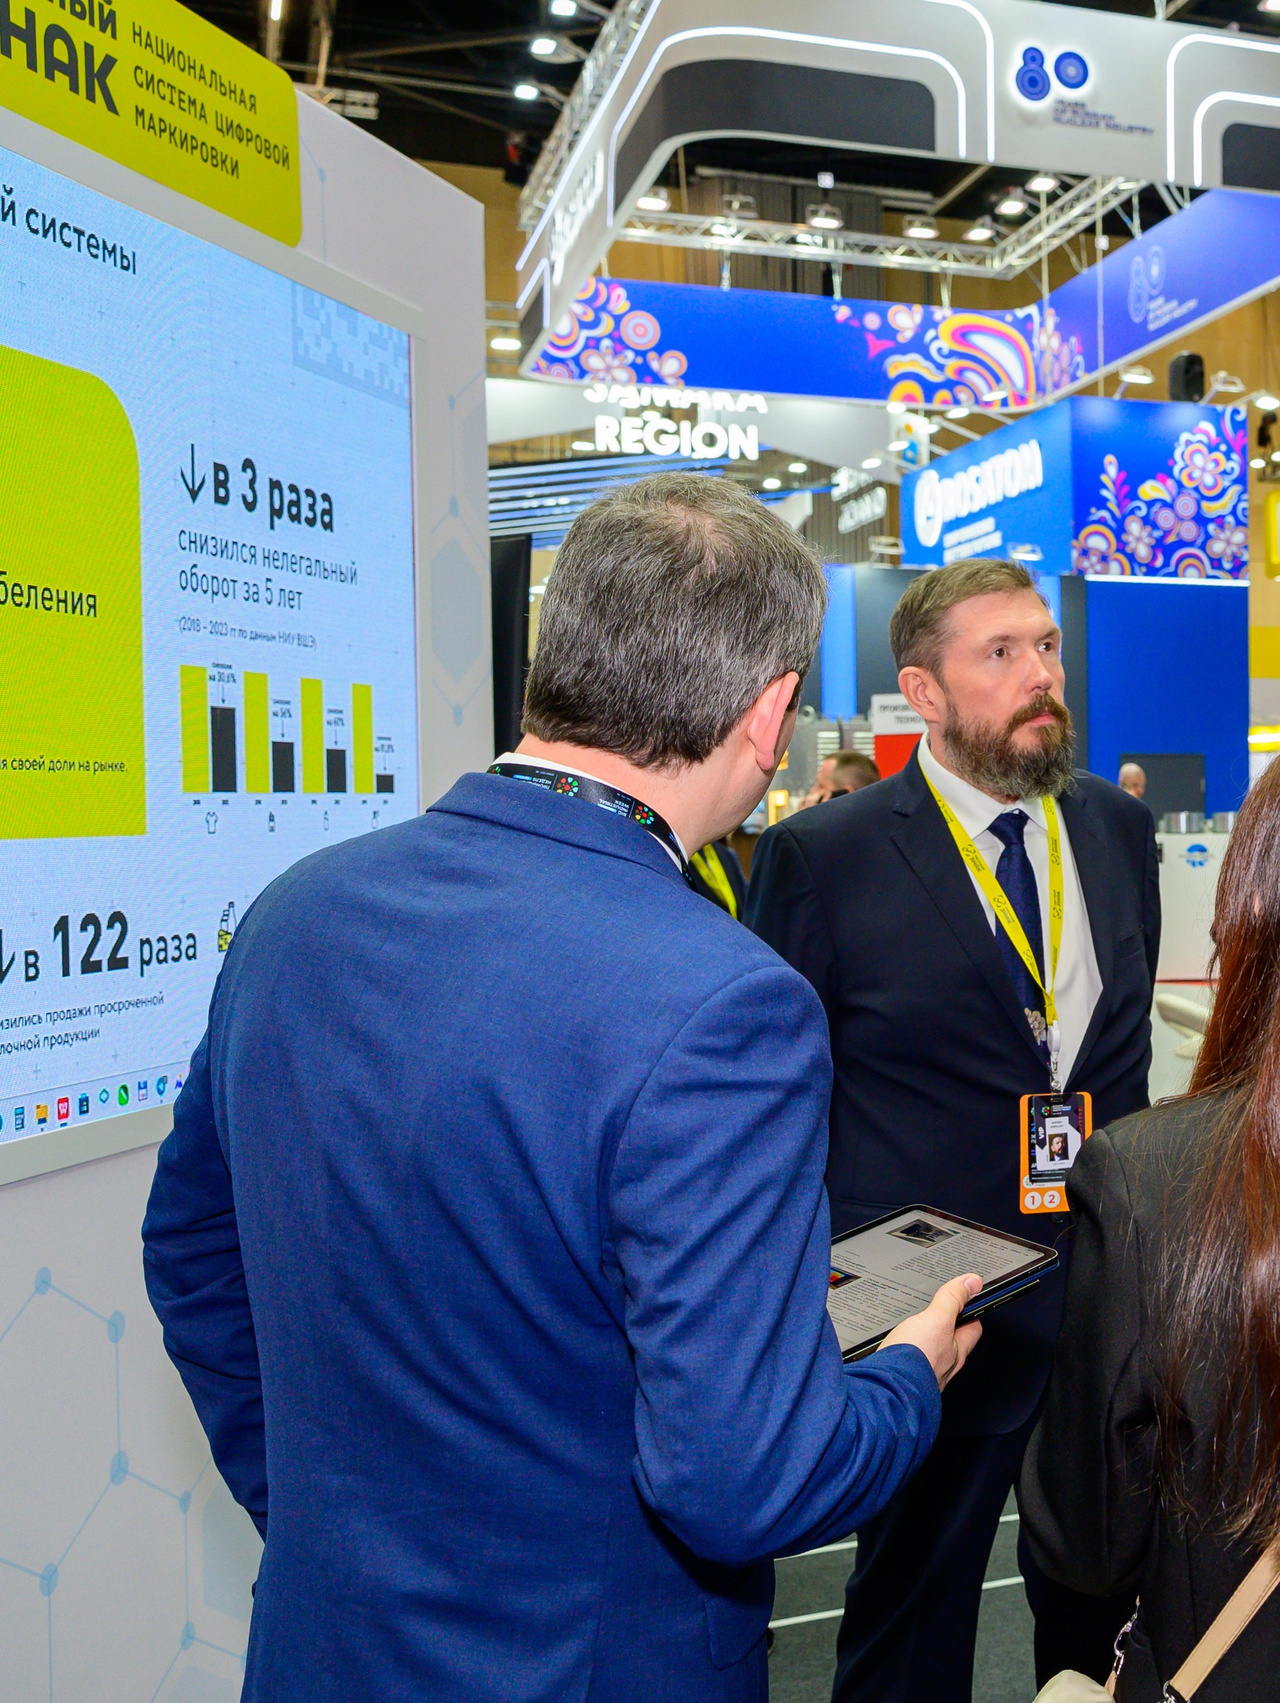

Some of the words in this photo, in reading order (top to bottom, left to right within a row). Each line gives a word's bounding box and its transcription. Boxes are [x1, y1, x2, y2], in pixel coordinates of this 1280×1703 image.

[48, 0, 117, 40] ЫЙ
[0, 0, 120, 117] НАК
[132, 21, 257, 115] НАЦИОНАЛЬНАЯ
[133, 65, 208, 125] СИСТЕМА
[215, 110, 290, 171] ЦИФРОВОЙ
[135, 104, 240, 180] МАРКИРОВКИ
[25, 207, 137, 275] системы
[594, 415, 759, 461] REGION
[213, 461, 230, 506] в
[241, 457, 258, 512] 3
[268, 477, 334, 533] раза
[178, 529, 257, 566] снизился
[262, 547, 358, 586] нелегальный
[179, 563, 238, 603] оборот
[243, 581, 260, 603] за
[265, 577, 274, 606] 5
[278, 588, 303, 611] лет
[209, 620, 228, 636] 2023
[10, 755, 46, 771] своей
[48, 759, 76, 773] доли
[78, 760, 91, 772] на
[93, 760, 128, 775] рынке.
[24, 949, 40, 983] в
[53, 910, 129, 978] 122
[139, 932, 198, 978] раза
[45, 1005, 92, 1026] продажи
[94, 990, 165, 1018] просроченной
[43, 1027, 101, 1050] продукции
[1048, 1194, 1056, 1204] 2
